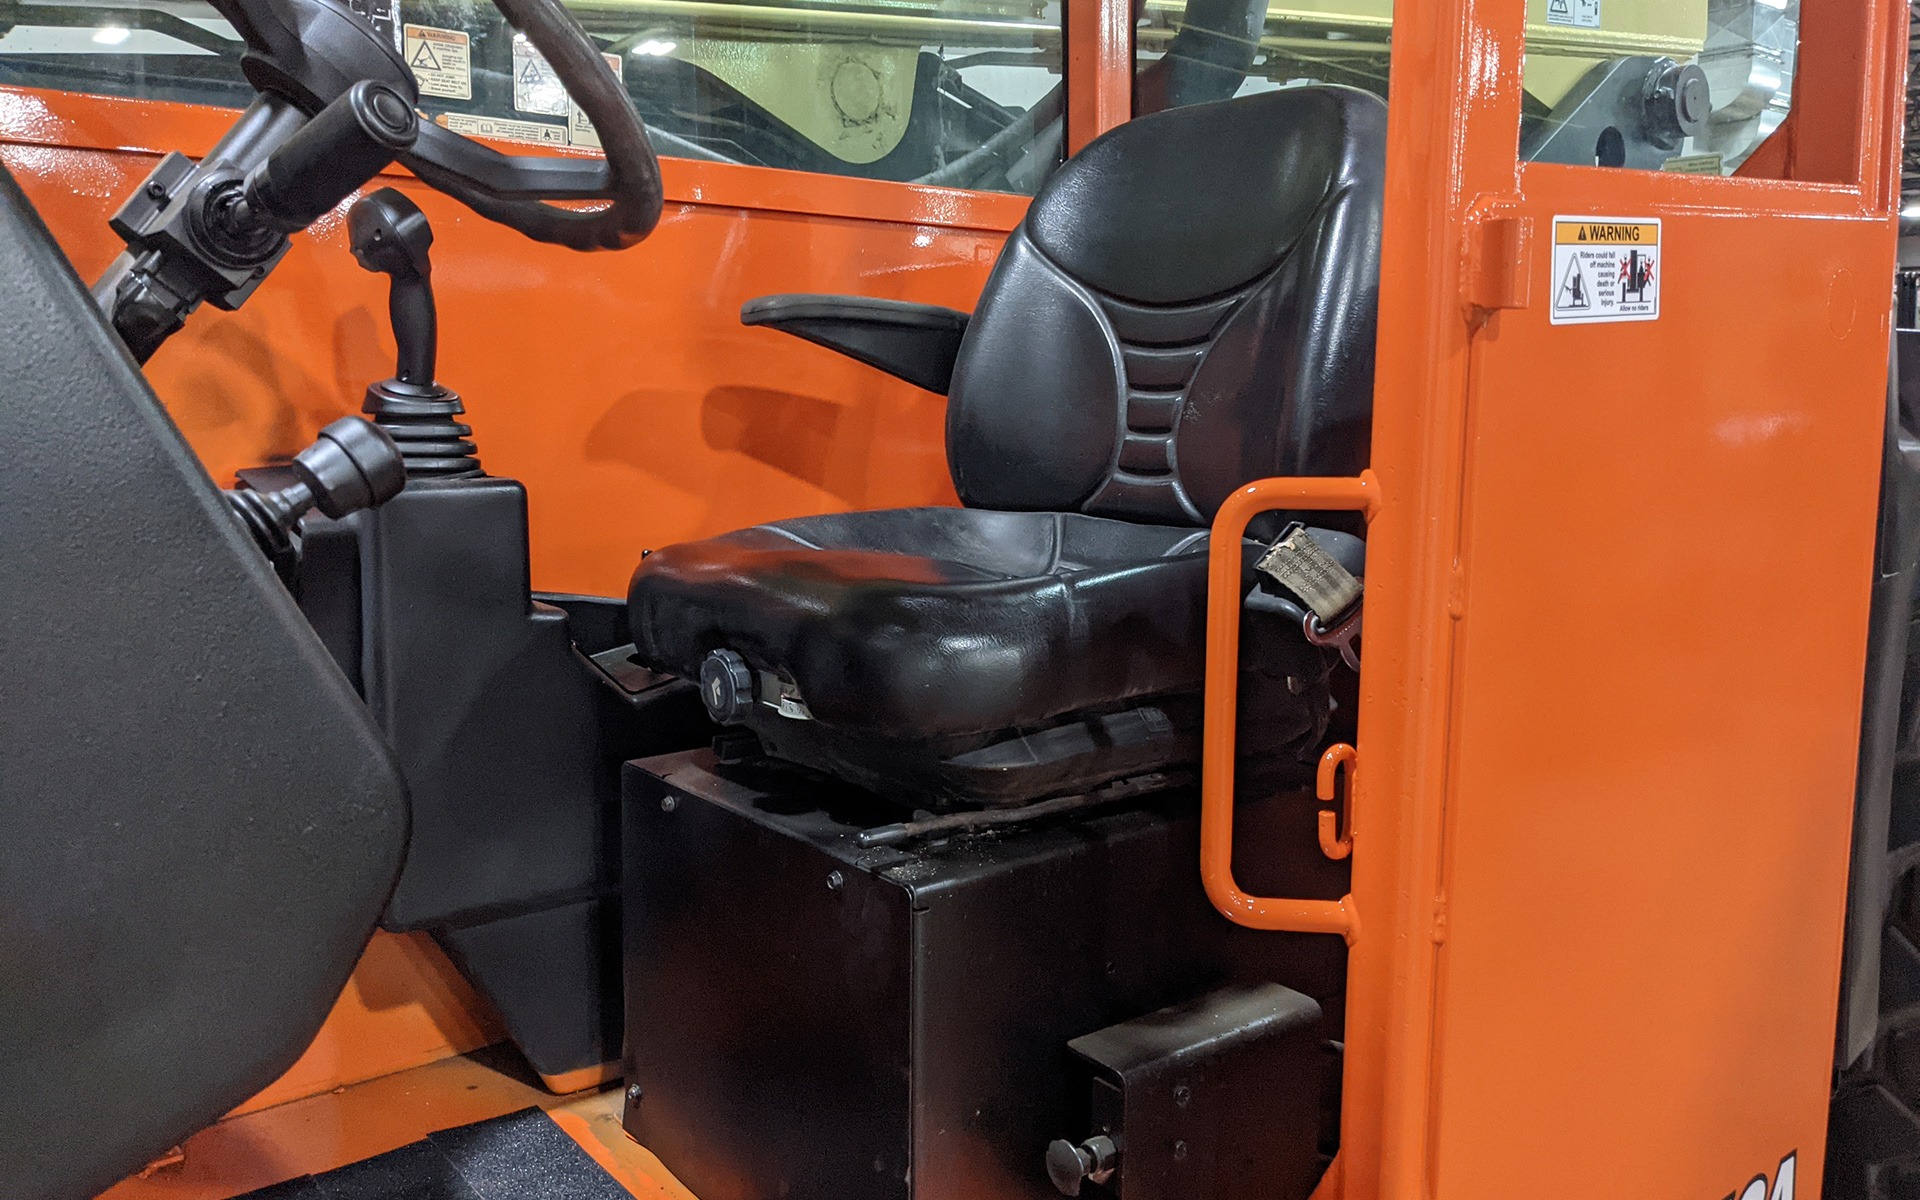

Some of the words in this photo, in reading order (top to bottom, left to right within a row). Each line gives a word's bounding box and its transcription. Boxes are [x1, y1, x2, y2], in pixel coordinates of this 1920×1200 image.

[427, 32, 456, 40] WARNING
[1589, 225, 1640, 241] WARNING
[1580, 251, 1594, 259] Riders
[1595, 251, 1608, 259] could
[1598, 271, 1615, 279] causing
[1598, 289, 1614, 297] serious
